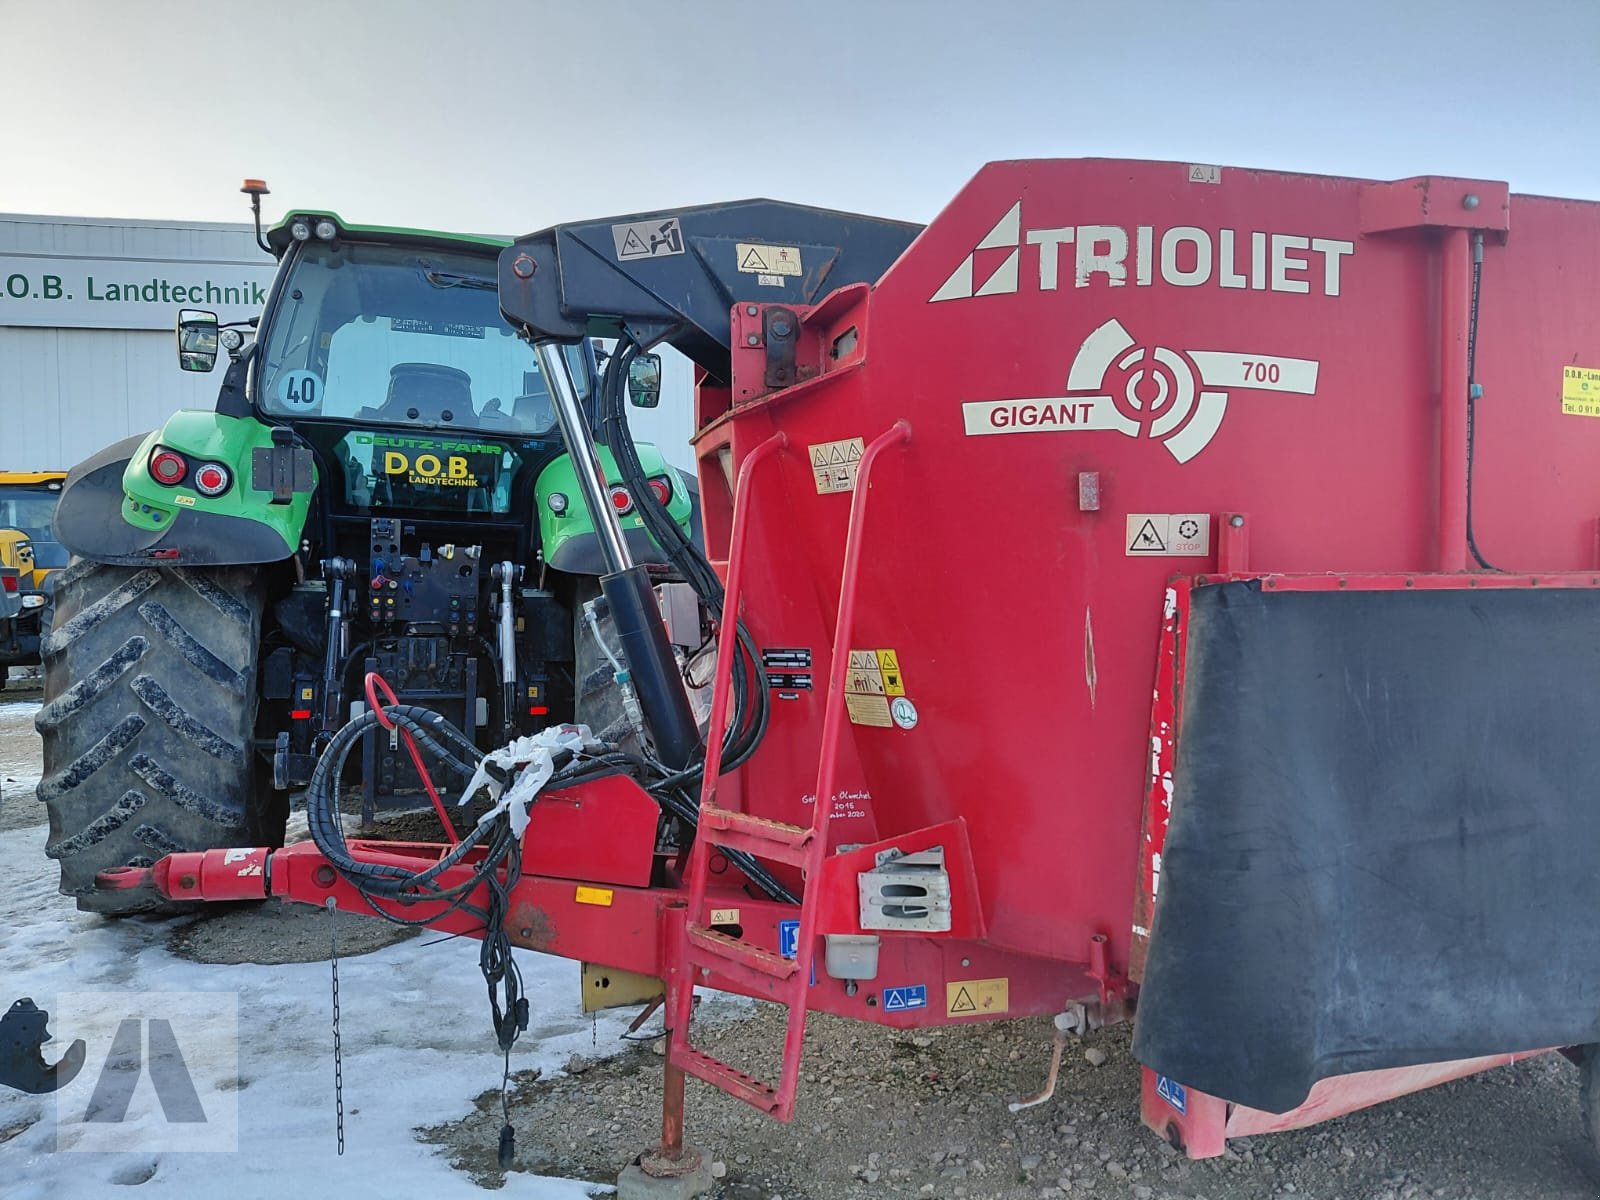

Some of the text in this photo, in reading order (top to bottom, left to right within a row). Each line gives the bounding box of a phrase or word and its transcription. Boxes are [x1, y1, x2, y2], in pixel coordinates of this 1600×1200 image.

[1025, 224, 1355, 296] TRIOLIET
[87, 276, 267, 305] Landtechnik
[1242, 361, 1280, 384] 700
[286, 376, 315, 404] 40
[990, 403, 1094, 428] GIGANT
[356, 436, 501, 454] DEUTZ-FAHR
[384, 451, 475, 479] D.O.B.
[408, 475, 478, 487] LANDTECHNIK
[1176, 543, 1200, 551] STOP
